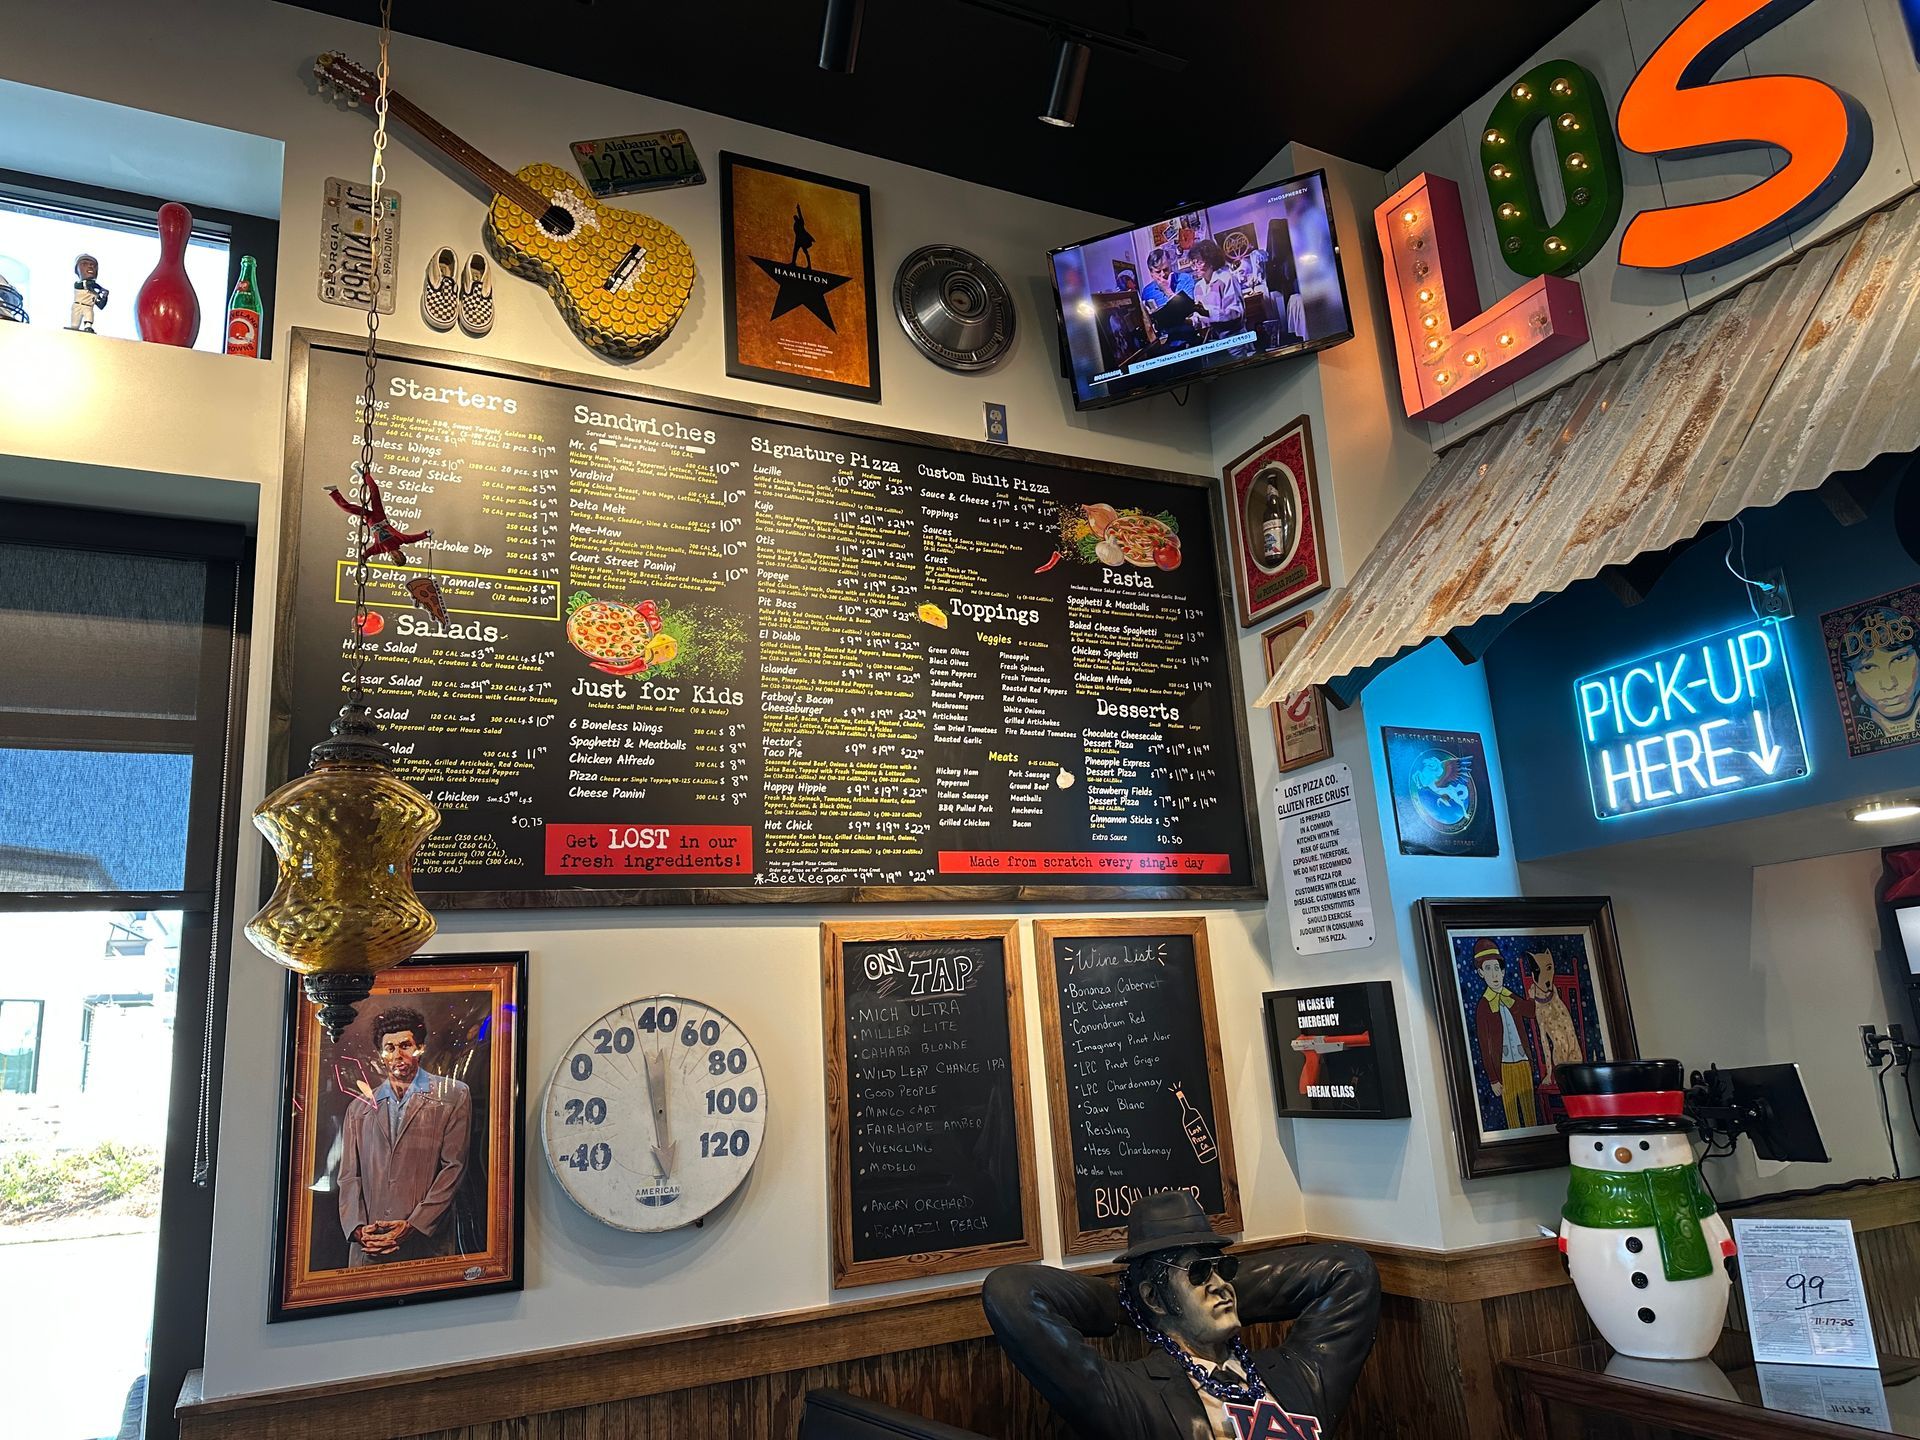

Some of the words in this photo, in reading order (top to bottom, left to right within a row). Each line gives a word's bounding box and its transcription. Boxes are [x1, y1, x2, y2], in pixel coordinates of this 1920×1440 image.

[604, 138, 660, 152] Alabama
[1374, 0, 1920, 422] LOS
[383, 227, 393, 275] SPALDING
[325, 223, 340, 299] GEORGIA
[774, 267, 829, 285] HAMILTON
[389, 376, 518, 415] Starters
[573, 405, 716, 445] Sandwiches
[750, 436, 845, 465] Signature
[849, 452, 901, 474] Pizza
[569, 468, 614, 483] Yardbird
[752, 464, 782, 476] Lucille
[917, 464, 966, 482] Custom
[972, 472, 1010, 488] Built
[1013, 478, 1050, 494] Pizza
[921, 506, 959, 521] Toppings
[569, 523, 622, 538] Mee-Maw
[569, 551, 600, 564] Court
[604, 555, 640, 569] Street
[643, 558, 677, 573] Panini
[924, 554, 948, 565] Crust
[756, 568, 790, 582] Popeye
[1102, 568, 1154, 589] Pasta
[950, 598, 1040, 626] Toppings
[1863, 611, 1885, 627] THE
[396, 614, 499, 643] Salads
[1843, 615, 1914, 657] DOORS
[976, 631, 1012, 646] Veggies
[1071, 645, 1101, 656] Chicken
[1103, 648, 1139, 660] Spaghetti
[571, 678, 627, 699] Just
[639, 681, 681, 702] for
[692, 685, 745, 706] Kids
[1580, 629, 1773, 742] PICK-UP
[931, 701, 969, 711] Mushrooms
[1096, 698, 1180, 721] Desserts
[1082, 729, 1119, 740] Chocolate
[1120, 730, 1163, 741] Cheesecake
[1857, 720, 1875, 732] ARS
[1858, 728, 1885, 741] NOVA
[568, 753, 613, 765] Chicken
[616, 754, 655, 766] Alfredo
[988, 750, 1019, 763] Meats
[1601, 718, 1742, 809] HERE
[763, 781, 794, 795] Happy
[797, 782, 827, 794] Hippie
[1284, 784, 1302, 799] LOST
[1301, 780, 1324, 795] PIZZA
[1324, 775, 1338, 788] CO.
[436, 791, 480, 802] Chicken
[1277, 799, 1306, 815] GLUTEN
[1306, 794, 1324, 808] FREE
[1324, 786, 1350, 803] CRUST
[511, 816, 543, 829] $0.75
[764, 820, 783, 830] Hot
[785, 820, 813, 831] Chick
[1012, 819, 1032, 828] Bacon
[428, 833, 452, 842] Caesar
[454, 833, 472, 842] (250
[473, 834, 494, 843] CAL),
[565, 834, 598, 848] Get
[608, 827, 670, 849] LOST
[679, 835, 700, 849] in
[708, 837, 737, 849] our
[1157, 834, 1183, 845] $0.50
[1296, 834, 1317, 845] KITCHEN
[1300, 844, 1312, 854] RISK
[1312, 842, 1319, 852] OF
[1319, 839, 1339, 851] GLUTEN
[559, 854, 614, 868] fresh
[623, 853, 742, 871] ingredients!
[969, 855, 1000, 867] Made
[1007, 856, 1037, 867] from
[1043, 856, 1093, 867] scratch
[1099, 858, 1134, 870] every
[1139, 857, 1178, 870] single
[1184, 858, 1205, 870] day
[1304, 874, 1317, 884] THIS
[1316, 871, 1331, 882] PIZZA
[1332, 869, 1343, 879] FOR
[1294, 884, 1325, 896] CUSTOMERS
[1325, 880, 1338, 891] WITH
[1337, 877, 1357, 889] CELIAC
[1076, 947, 1119, 971] Wine
[1123, 945, 1156, 964] List
[864, 948, 905, 981] ON
[907, 955, 973, 995] TAP
[1069, 983, 1112, 998] Bonanza
[1116, 974, 1166, 994] Cabernet
[858, 1007, 899, 1023] MICH
[910, 999, 961, 1017] ULTRA
[1071, 1002, 1088, 1015] LPC
[1092, 997, 1129, 1012] Cabernet
[1297, 999, 1306, 1012] IN
[1306, 997, 1325, 1012] CASE
[1325, 996, 1335, 1009] OF
[638, 1006, 678, 1034] 40
[1072, 1015, 1126, 1035] Conundrum
[1128, 1011, 1147, 1025] Red
[1297, 1013, 1340, 1029] EMERGENCY
[681, 1019, 721, 1047] 60
[860, 1025, 912, 1041] MILLER
[922, 1020, 958, 1034] LITE
[593, 1027, 635, 1054] 20
[1075, 1039, 1122, 1054] Imaginary
[1127, 1034, 1149, 1046] Pinot
[1152, 1031, 1172, 1042] Noir
[861, 1045, 911, 1060] CAHABA
[921, 1040, 968, 1054] BLONDE
[570, 1053, 593, 1082] 0
[708, 1048, 747, 1076] 80
[863, 1068, 897, 1081] WILD
[900, 1064, 929, 1078] LEAP
[935, 1061, 980, 1075] CHANCE
[986, 1057, 1006, 1072] IPA
[1079, 1060, 1097, 1077] LPC
[1104, 1059, 1129, 1071] Pinot
[1133, 1055, 1160, 1068] Grigio
[705, 1086, 758, 1115] 100
[864, 1088, 895, 1100] GOOD
[899, 1084, 938, 1097] PEOPLE
[1306, 1085, 1331, 1098] BREAK
[1331, 1085, 1355, 1098] GLASS
[865, 1105, 904, 1118] MANGO
[909, 1104, 938, 1115] CART
[1083, 1100, 1110, 1115] Sauv
[1116, 1098, 1145, 1111] Blanc
[866, 1121, 935, 1136] FAIRHOPE
[943, 1117, 984, 1131] AMBER
[1085, 1120, 1131, 1139] Reisling
[700, 1130, 750, 1158] 120
[867, 1142, 933, 1154] YUENGLING
[1087, 1143, 1111, 1156] Hess
[1118, 1141, 1172, 1160] Chardonnay
[869, 1162, 917, 1173] MODELO
[635, 1185, 681, 1196] AMERICAN
[871, 1199, 908, 1212] ANGRY
[914, 1195, 975, 1212] ORCHARD
[950, 1216, 989, 1232] PEACH
[1785, 1273, 1825, 1304] 99
